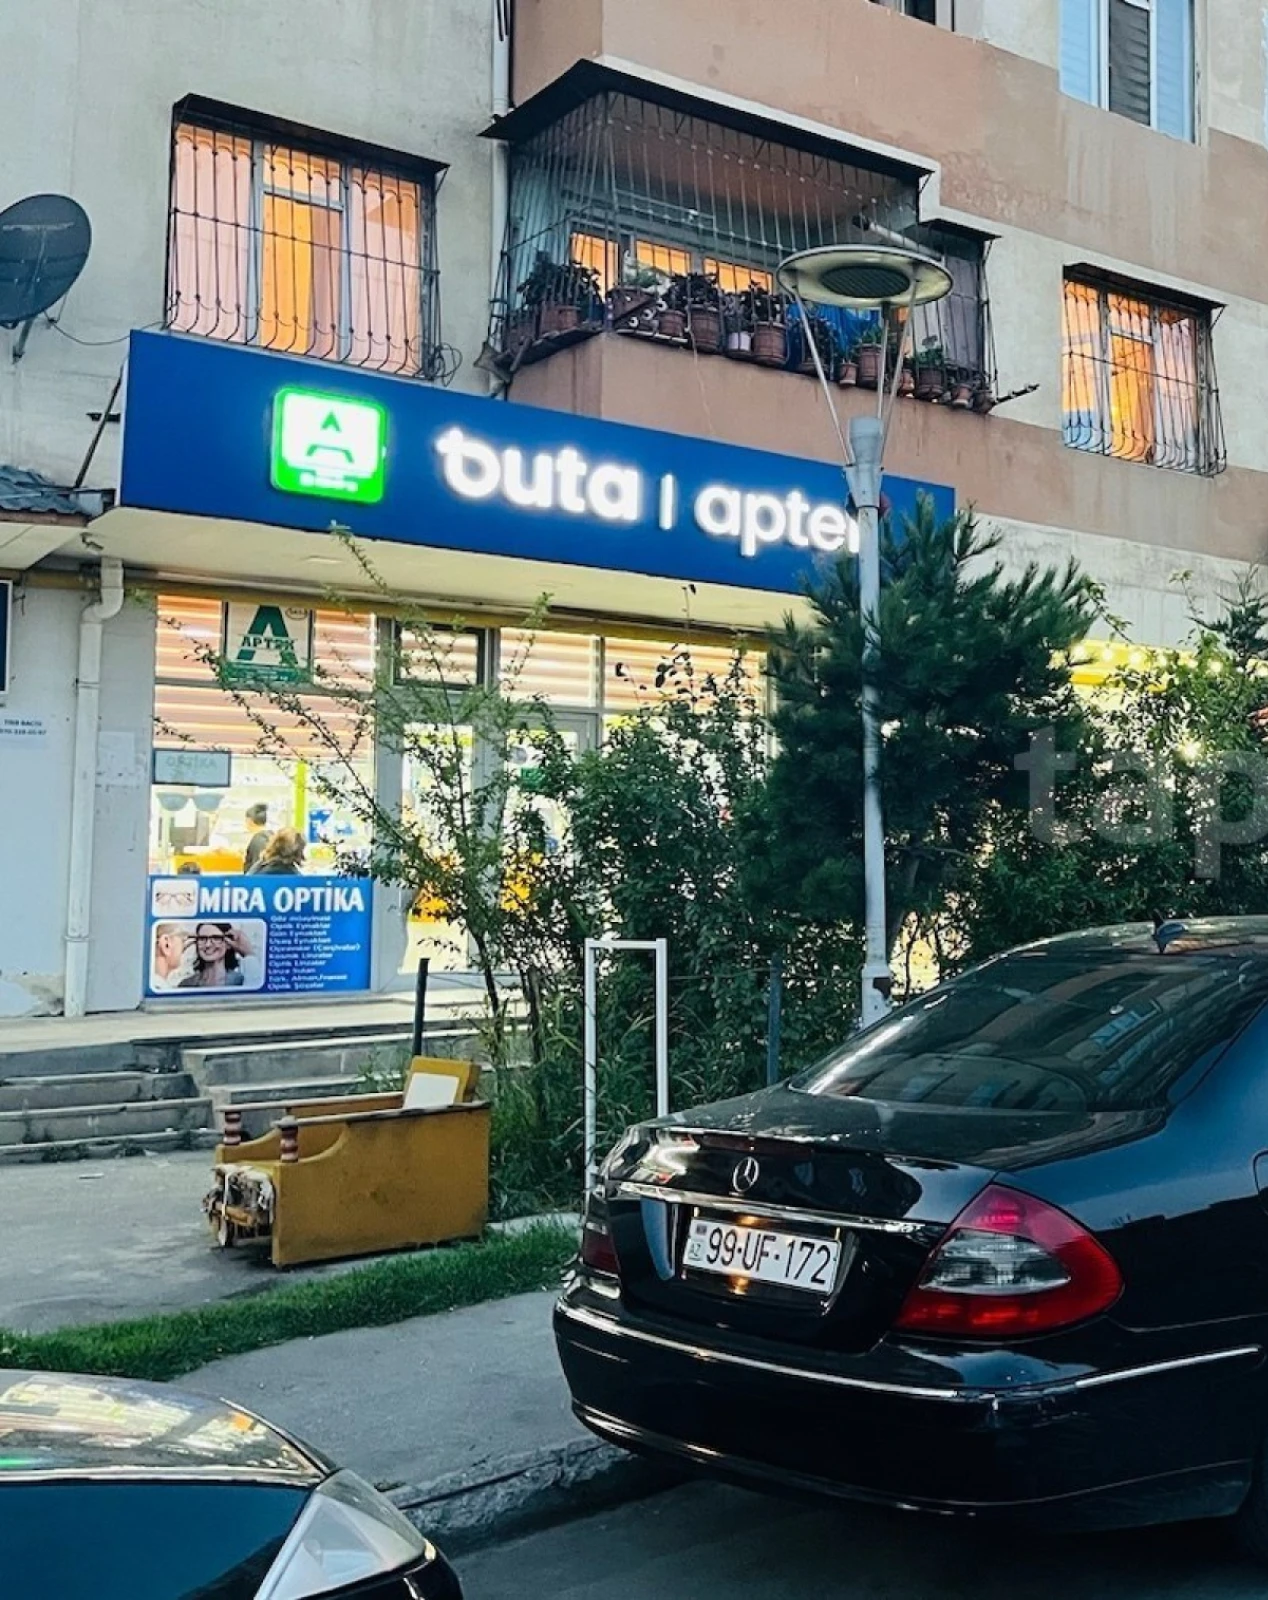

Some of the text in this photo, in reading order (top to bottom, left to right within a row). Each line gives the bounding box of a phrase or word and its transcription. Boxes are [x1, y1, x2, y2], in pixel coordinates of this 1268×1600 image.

[436, 427, 640, 521] buta
[200, 880, 365, 913] MİRA OPTİKA
